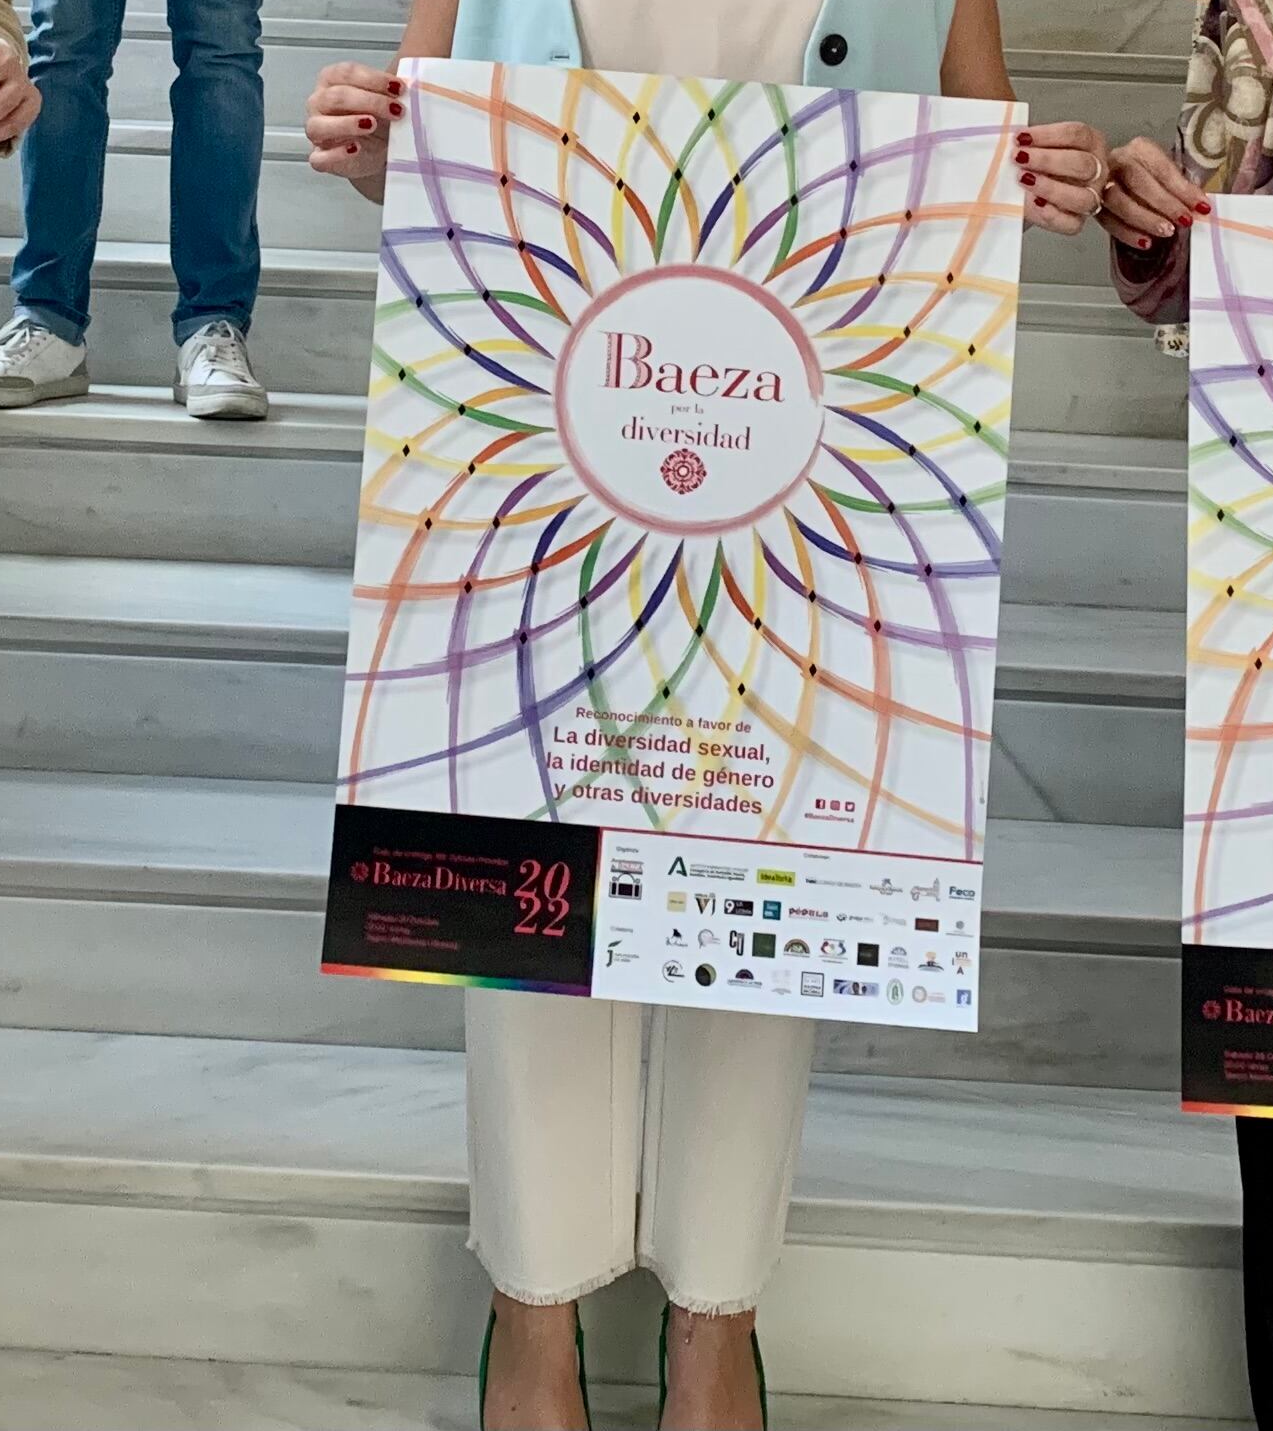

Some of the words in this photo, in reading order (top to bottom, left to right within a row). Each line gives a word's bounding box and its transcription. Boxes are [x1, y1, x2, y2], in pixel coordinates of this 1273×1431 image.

[597, 330, 785, 403] Baeza
[671, 404, 690, 415] por
[695, 404, 704, 414] la
[621, 416, 751, 450] diversidad
[576, 707, 682, 727] Reconocimiento
[686, 718, 694, 728] a
[698, 718, 732, 732] favor
[735, 721, 751, 733] de
[553, 726, 578, 745] La
[584, 729, 692, 755] diversidad
[698, 740, 771, 765] sexual,
[547, 752, 564, 770] la
[570, 754, 665, 778] identidad
[671, 763, 696, 782] de
[703, 767, 774, 790] género
[554, 784, 566, 801] y
[572, 783, 624, 802] otras
[631, 785, 763, 814] diversidades
[373, 861, 507, 896] BaezaDiversa
[514, 859, 570, 901] 20
[949, 886, 976, 898] Feco
[514, 893, 570, 937] 22
